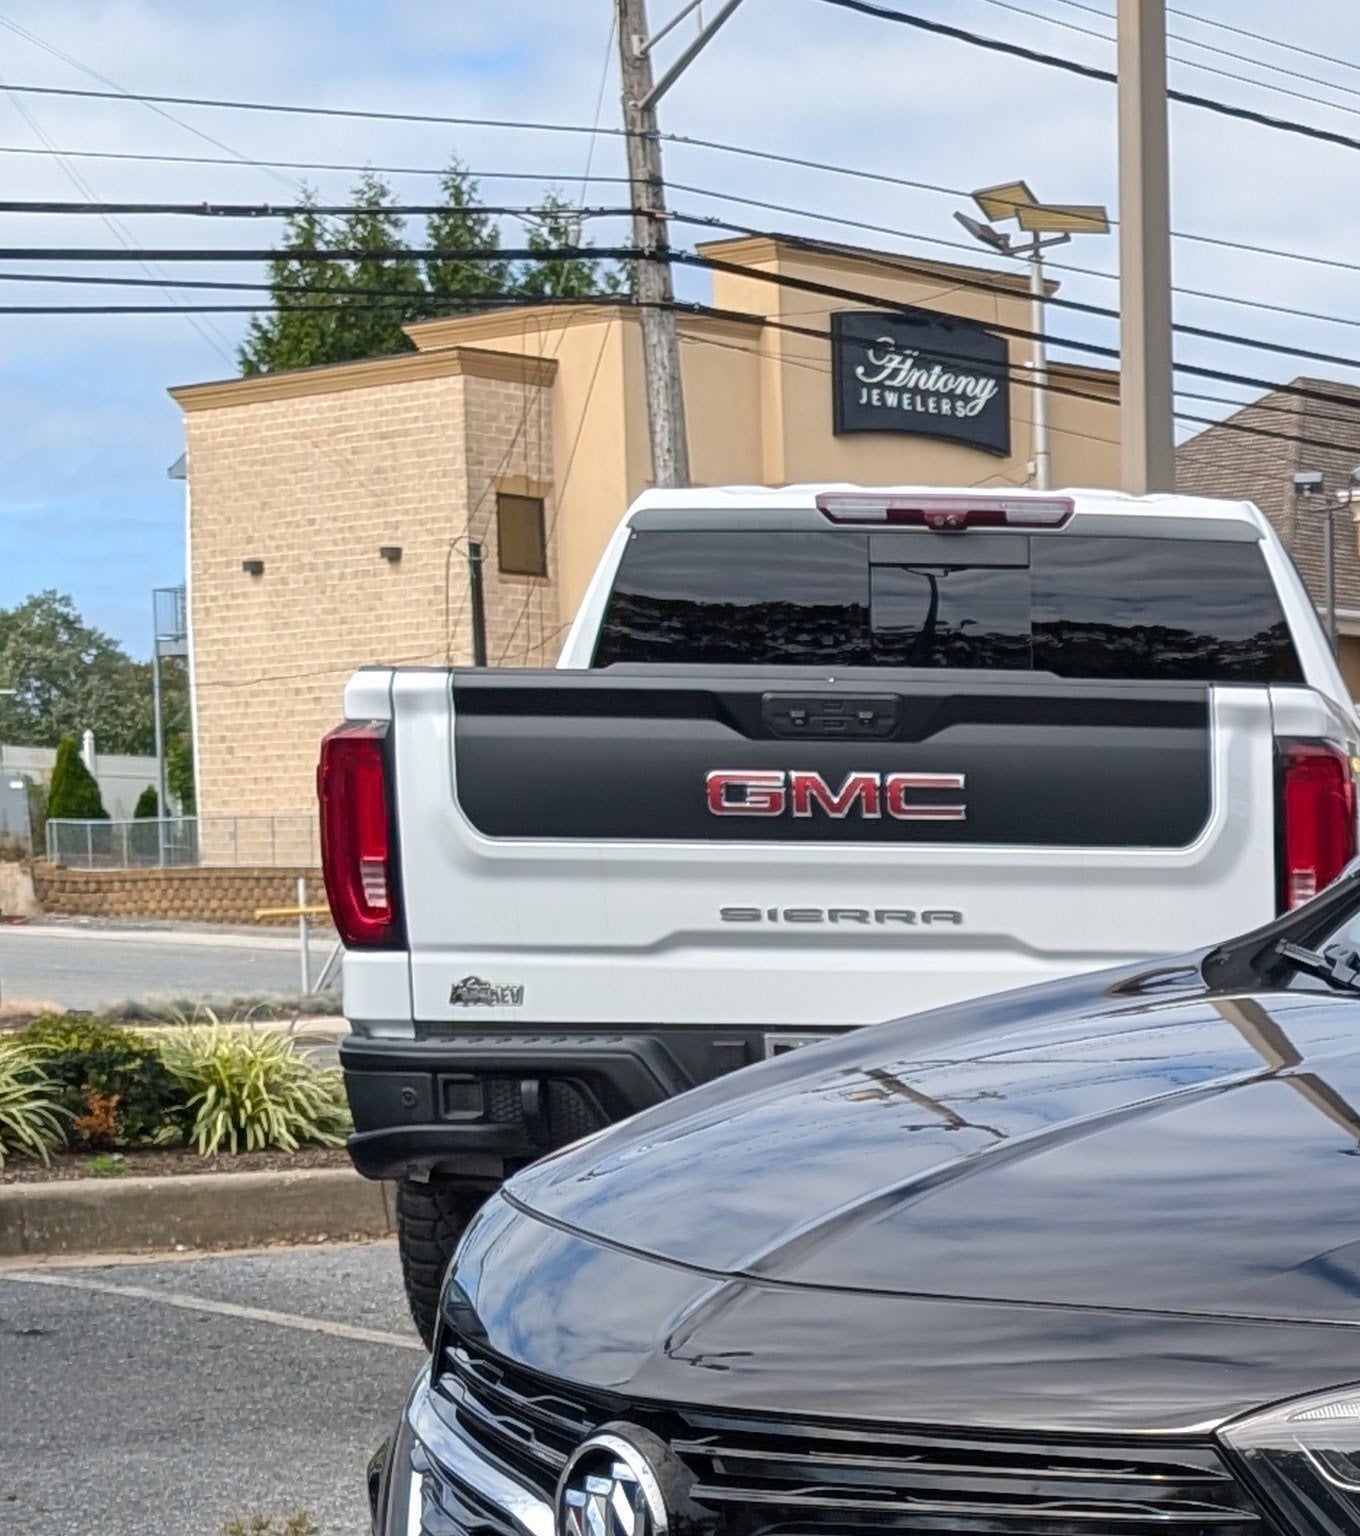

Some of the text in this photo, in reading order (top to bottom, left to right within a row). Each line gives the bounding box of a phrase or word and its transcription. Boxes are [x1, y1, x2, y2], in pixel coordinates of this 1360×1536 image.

[855, 336, 998, 416] Antony
[859, 387, 966, 418] JEWELERS
[706, 769, 967, 821] GMC
[719, 907, 963, 925] SIERRA
